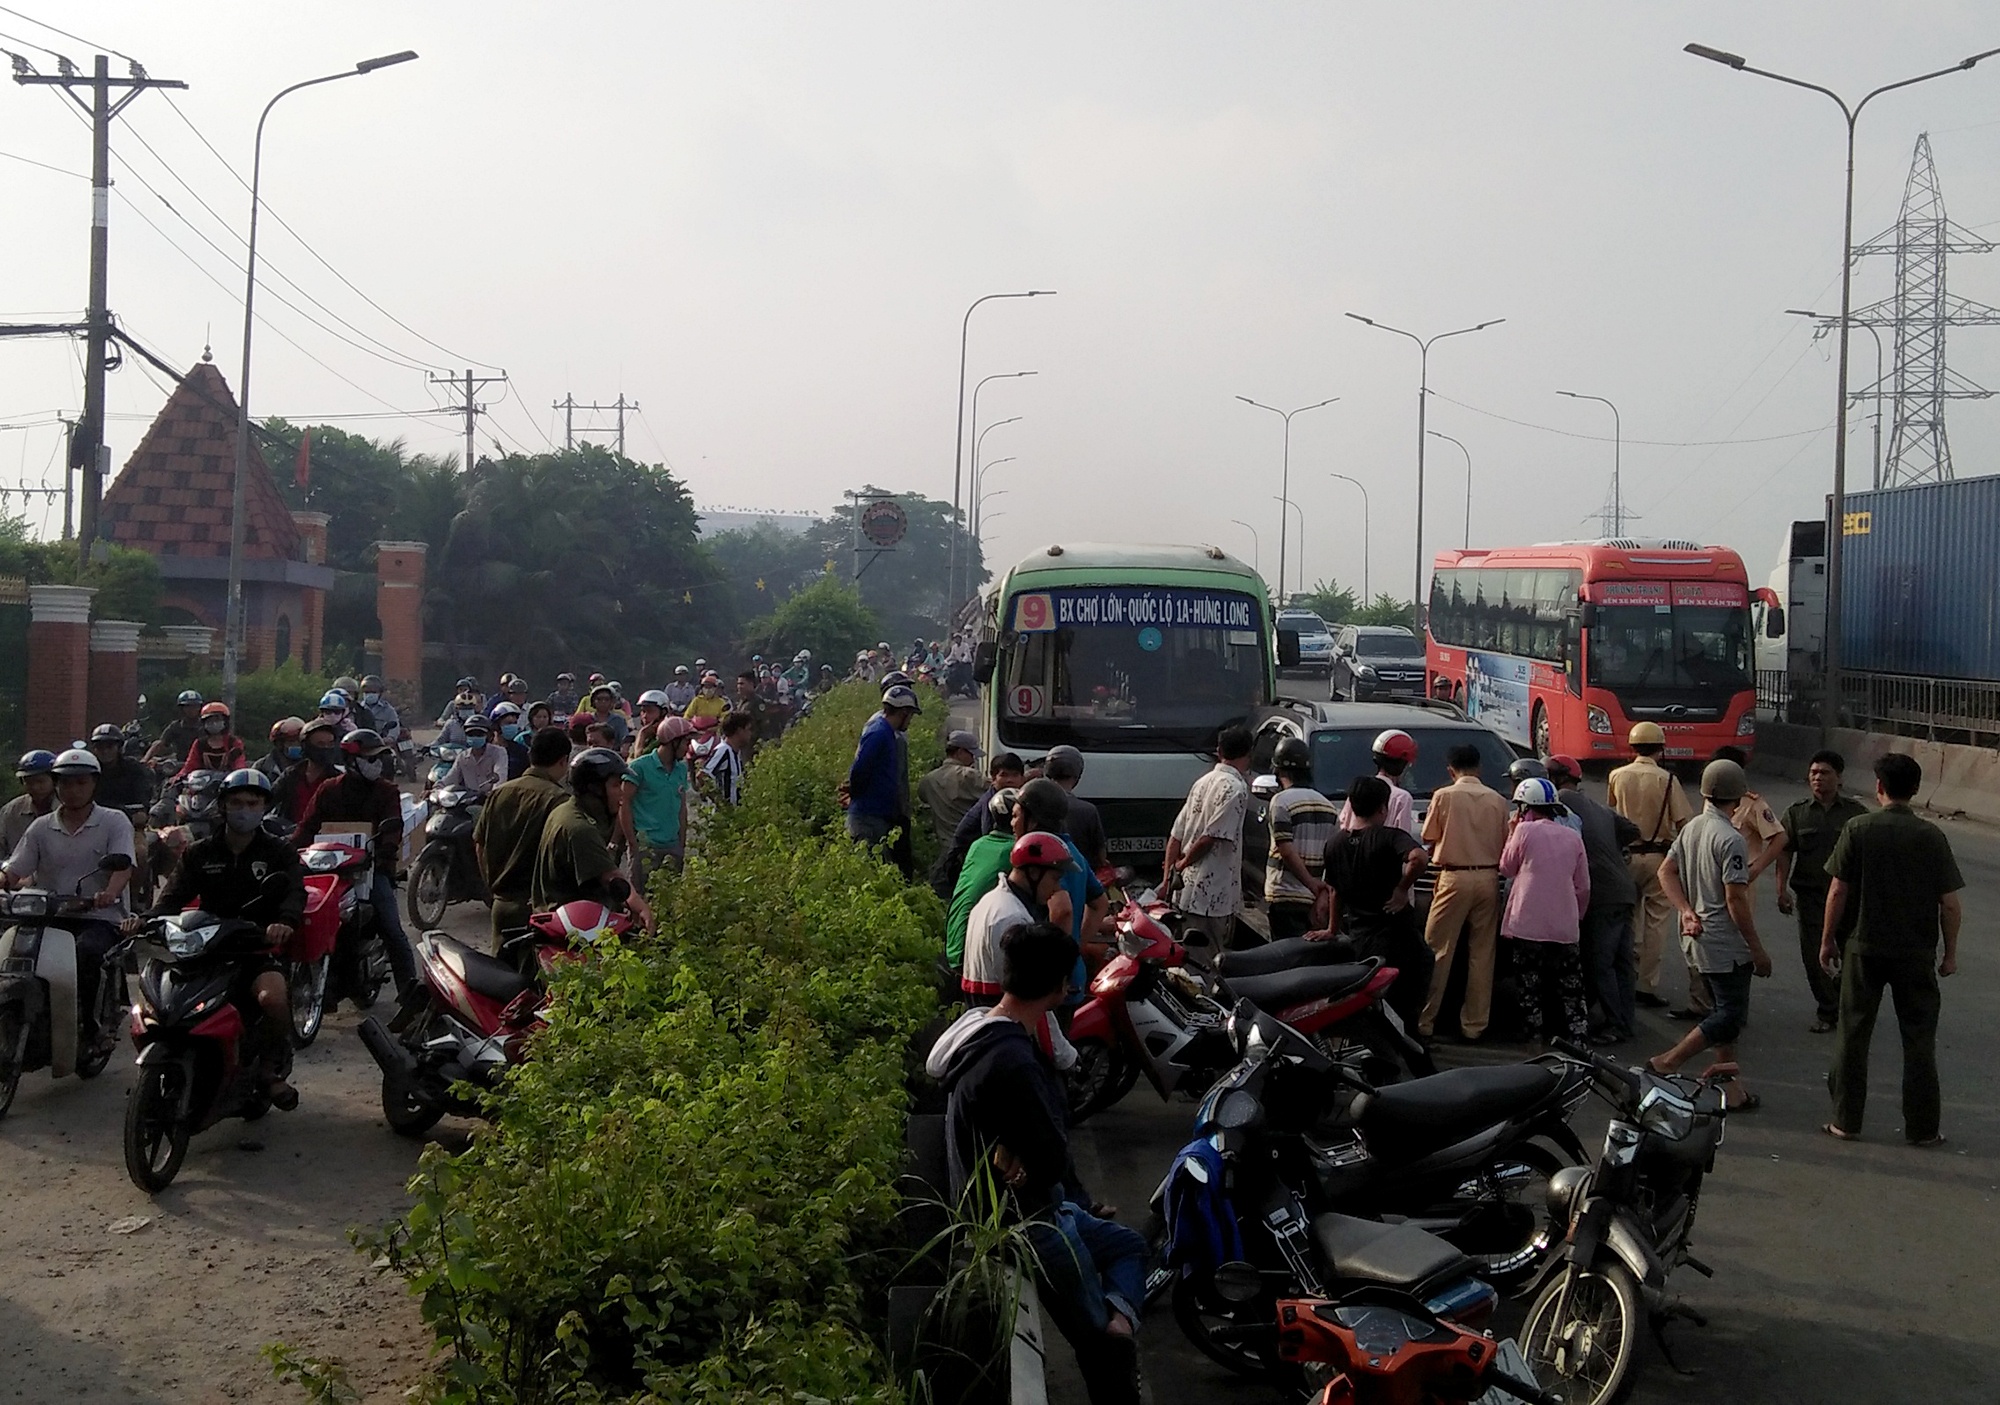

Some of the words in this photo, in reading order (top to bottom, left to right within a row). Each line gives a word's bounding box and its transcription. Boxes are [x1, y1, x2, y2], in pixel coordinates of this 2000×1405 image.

[1023, 596, 1047, 629] 9
[1060, 598, 1074, 622] BX
[1077, 595, 1099, 626] CHỢ
[1159, 593, 1173, 627] LỘ
[1223, 601, 1249, 626] LONG
[1018, 688, 1032, 714] 9
[1732, 855, 1743, 870] 3
